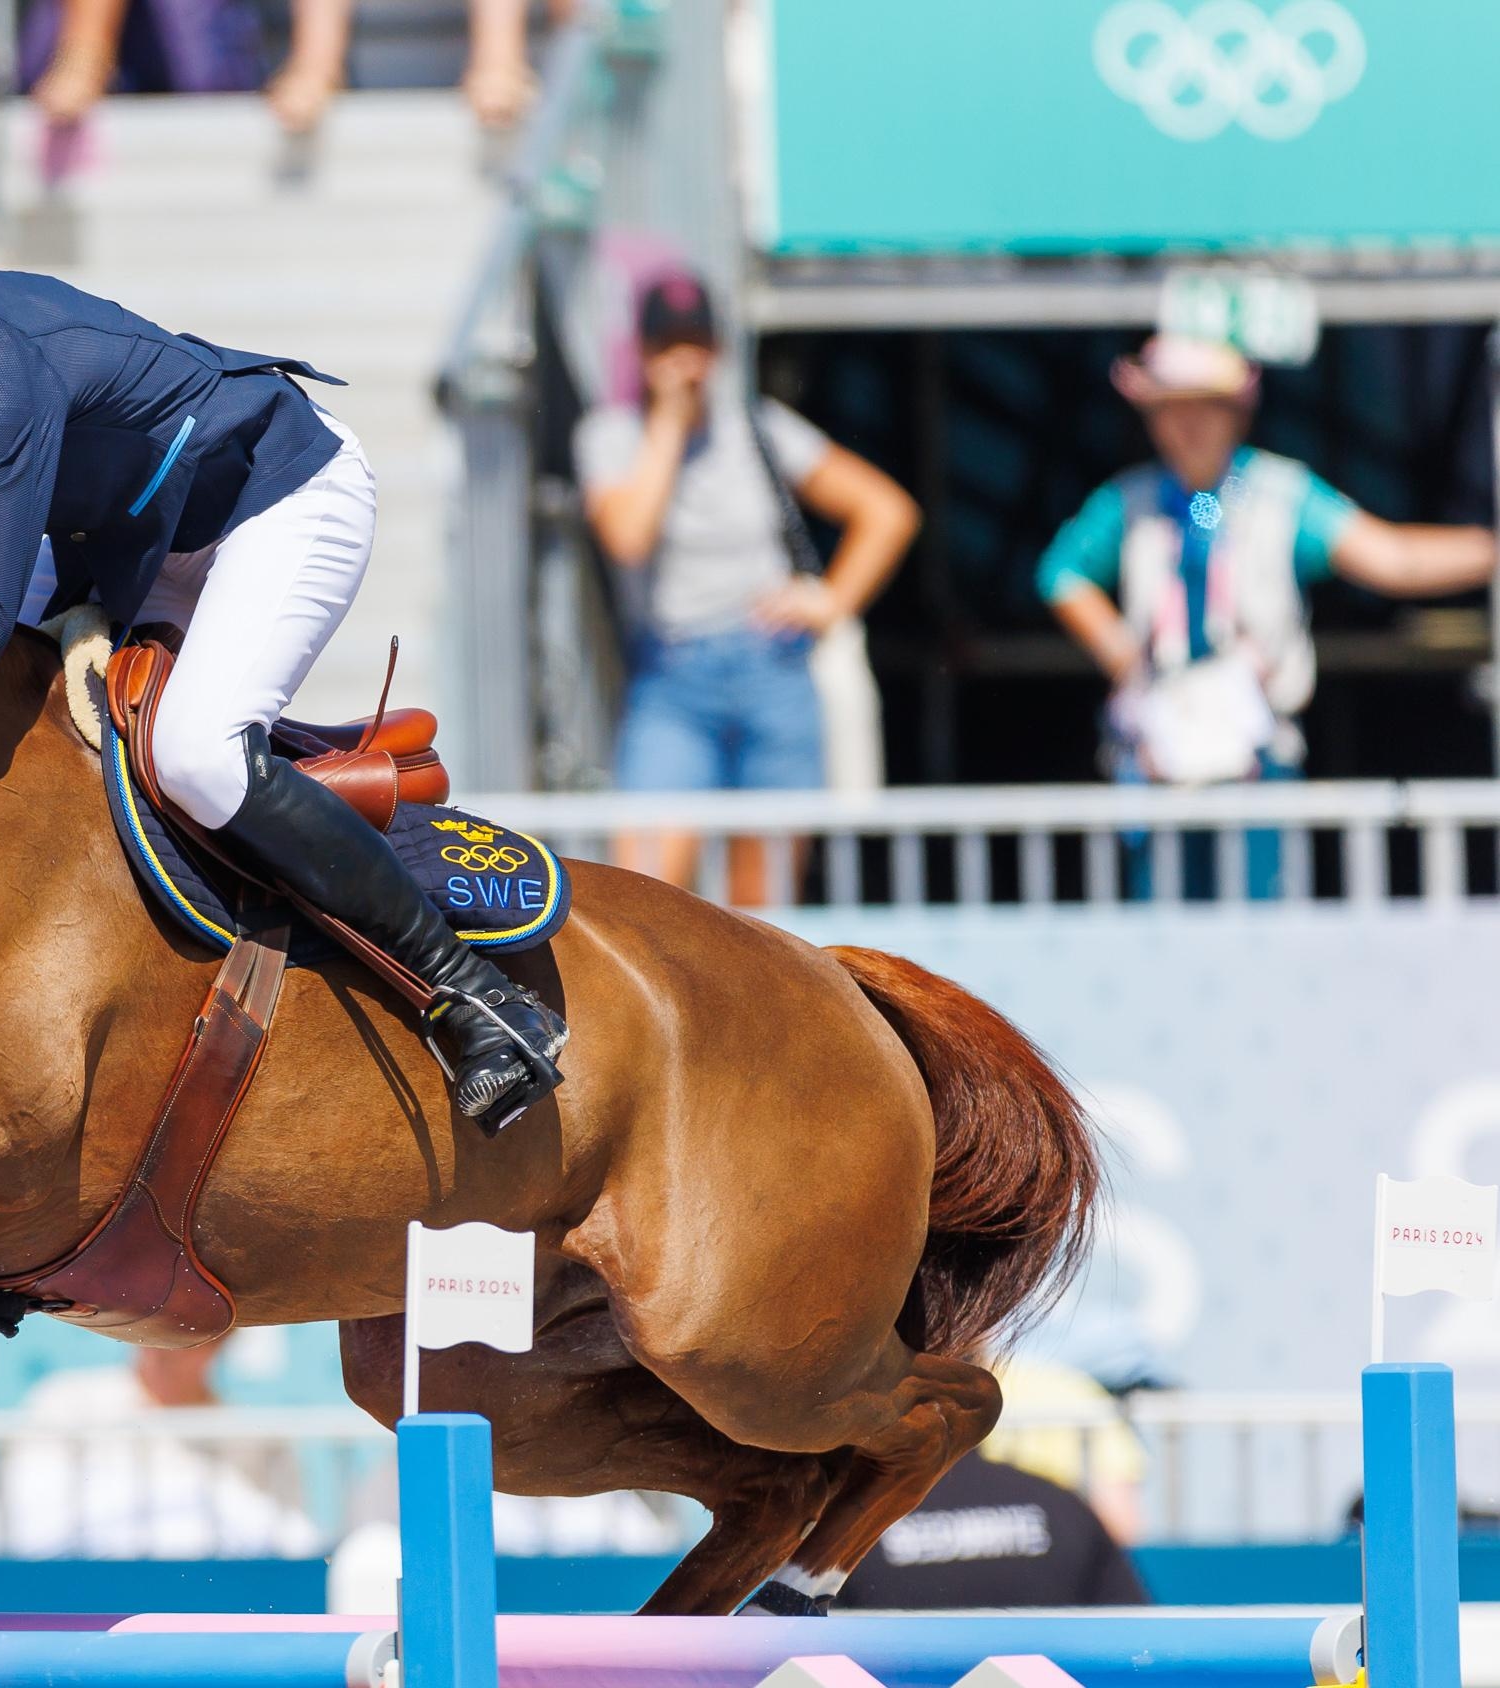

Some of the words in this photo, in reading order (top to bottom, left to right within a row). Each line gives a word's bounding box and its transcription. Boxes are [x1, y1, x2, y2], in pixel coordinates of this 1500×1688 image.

[447, 876, 545, 909] SWE
[1393, 1227, 1437, 1243] PARIS
[1443, 1230, 1483, 1245] 2024
[428, 1278, 473, 1293] PARIS
[479, 1280, 521, 1295] 2024
